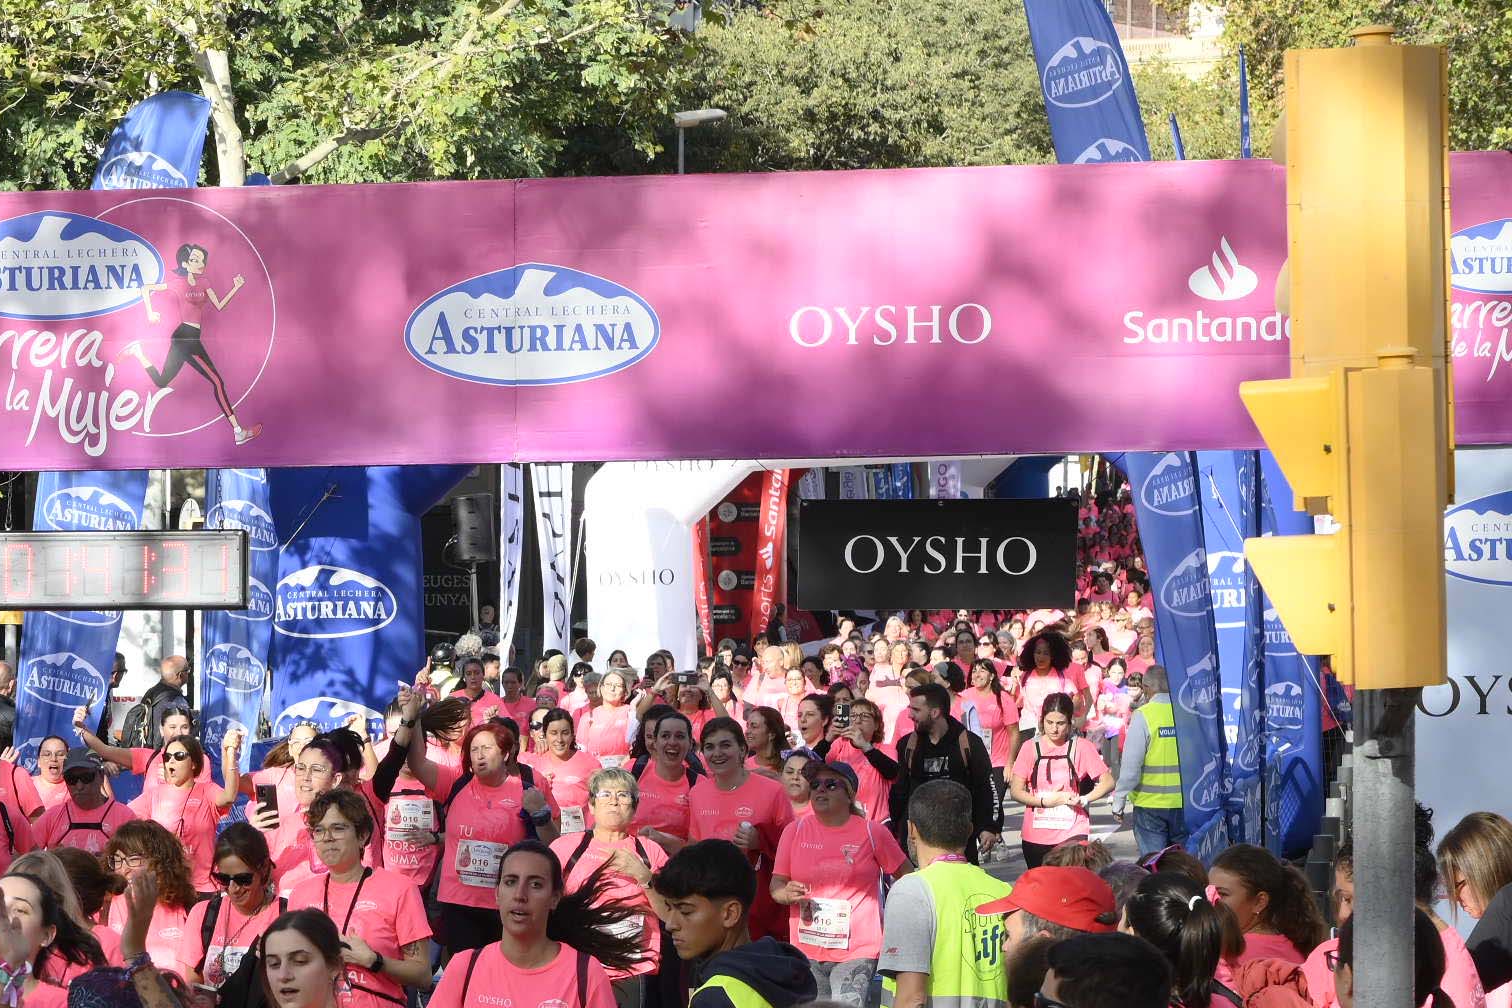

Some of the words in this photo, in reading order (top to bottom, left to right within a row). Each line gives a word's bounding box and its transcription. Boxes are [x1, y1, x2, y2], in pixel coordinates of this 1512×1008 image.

[66, 246, 139, 259] LECHERA
[463, 306, 542, 320] CENTRAL
[550, 304, 633, 318] LECHERA
[423, 310, 641, 355] ASTURIANA
[789, 303, 993, 347] OYSHO
[5, 369, 30, 411] la
[25, 362, 175, 457] Mujer
[844, 534, 1037, 576] OYSHO
[288, 590, 329, 599] CENTRAL
[334, 590, 383, 598] LECHERA
[274, 595, 388, 622] ASTURIANA
[25, 667, 98, 701] ASTURIANA
[458, 824, 473, 838] TU
[472, 857, 489, 867] 016
[478, 993, 512, 1008] OYSHO
